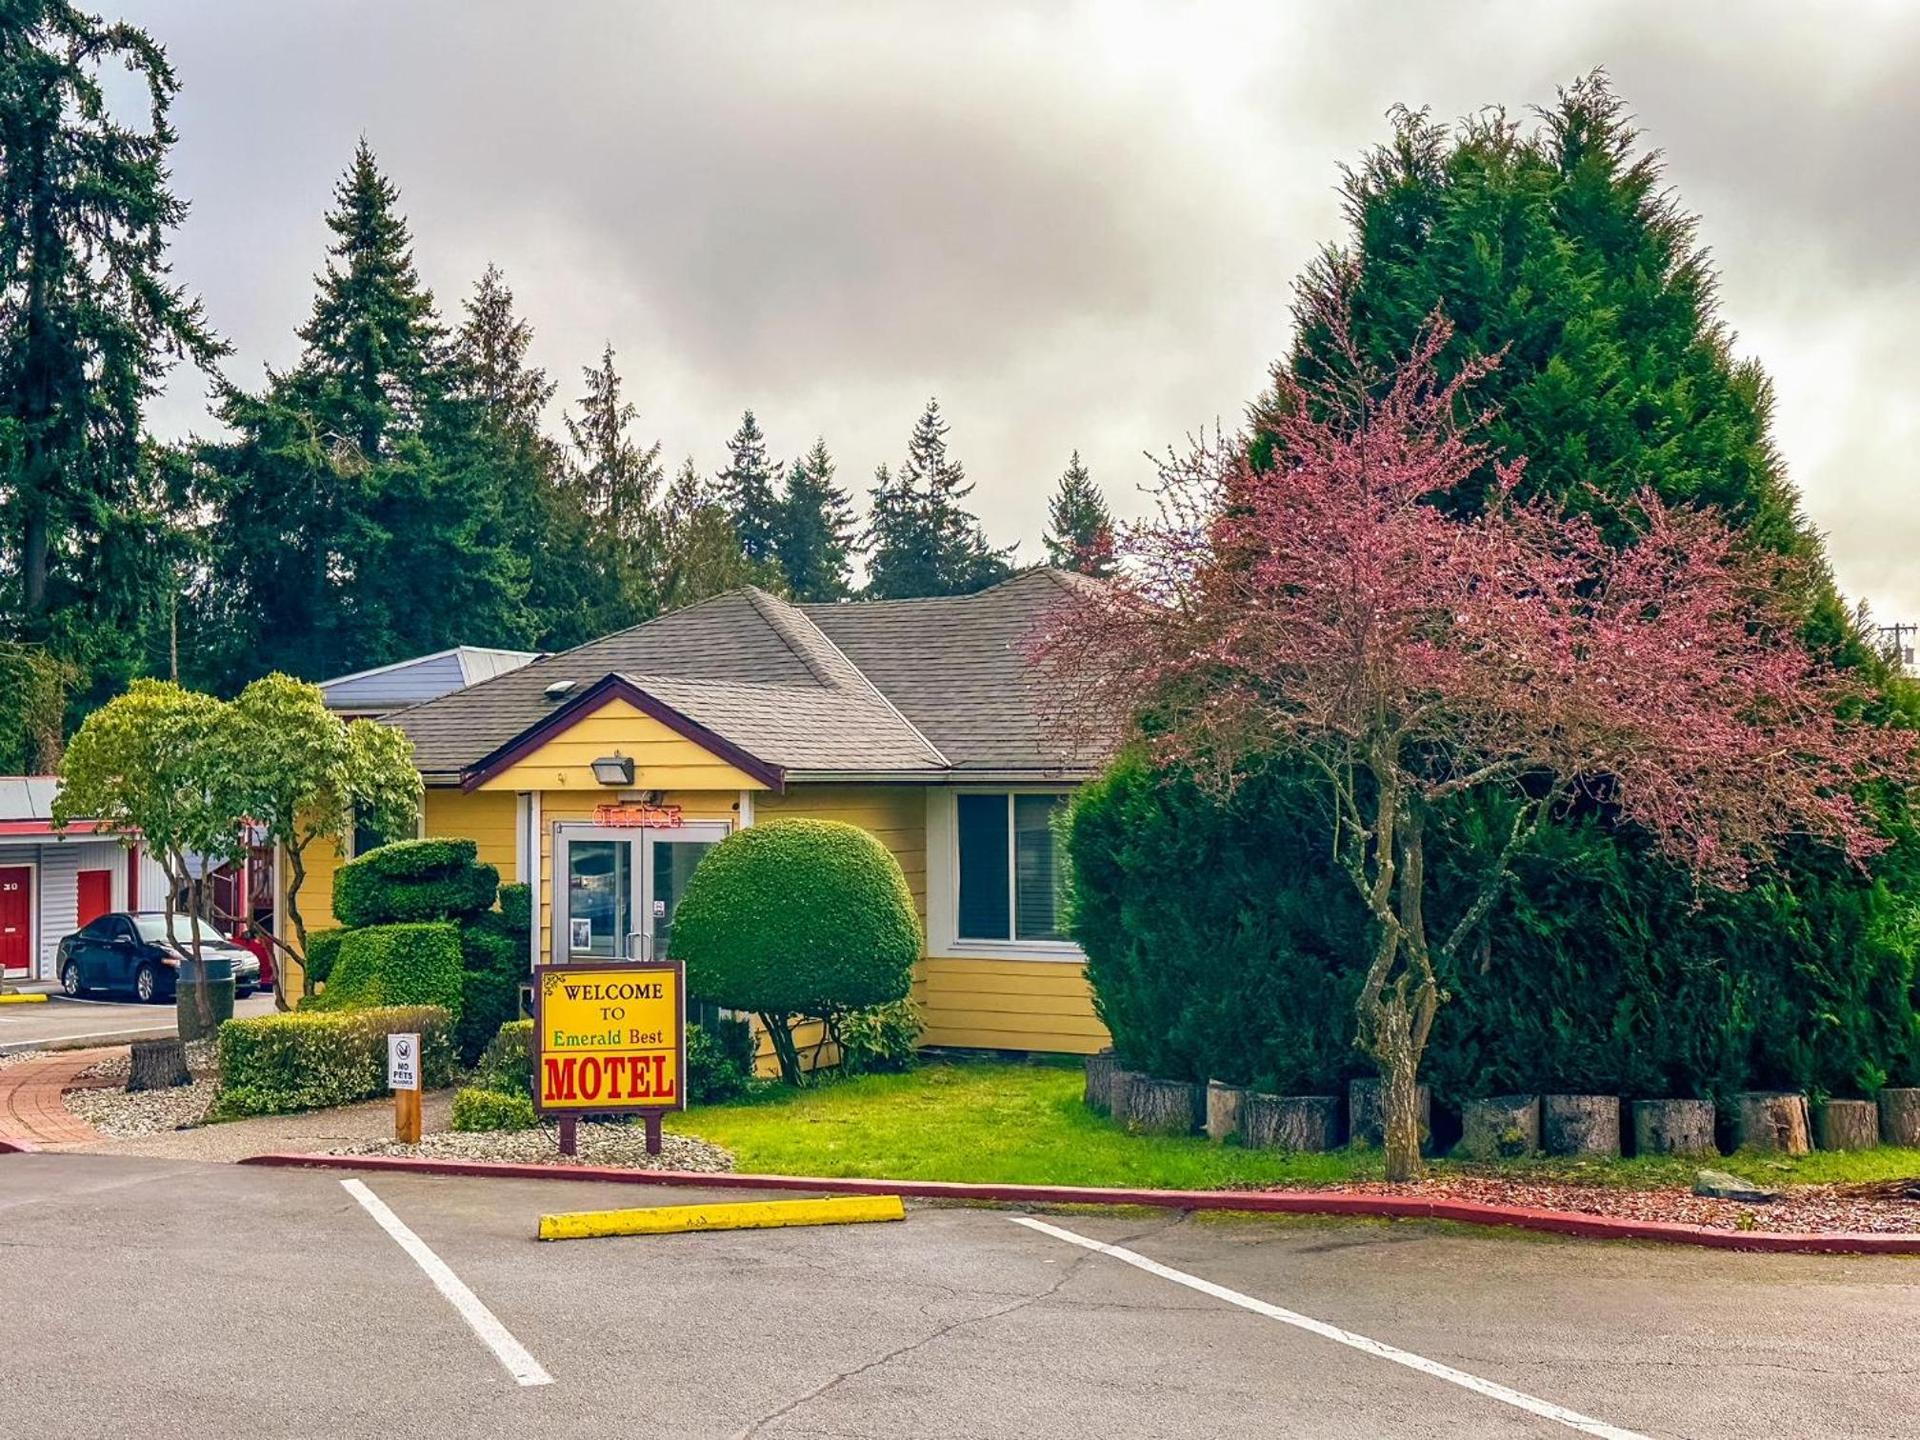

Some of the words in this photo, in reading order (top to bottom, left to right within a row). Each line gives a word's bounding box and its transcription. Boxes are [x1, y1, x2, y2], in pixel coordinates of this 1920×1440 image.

[564, 983, 663, 1000] WELCOME
[600, 1007, 625, 1020] TO
[553, 1029, 621, 1047] Emerald
[629, 1028, 663, 1044] Best
[398, 1062, 409, 1070] NO
[393, 1071, 413, 1080] PETS
[544, 1055, 674, 1101] MOTEL
